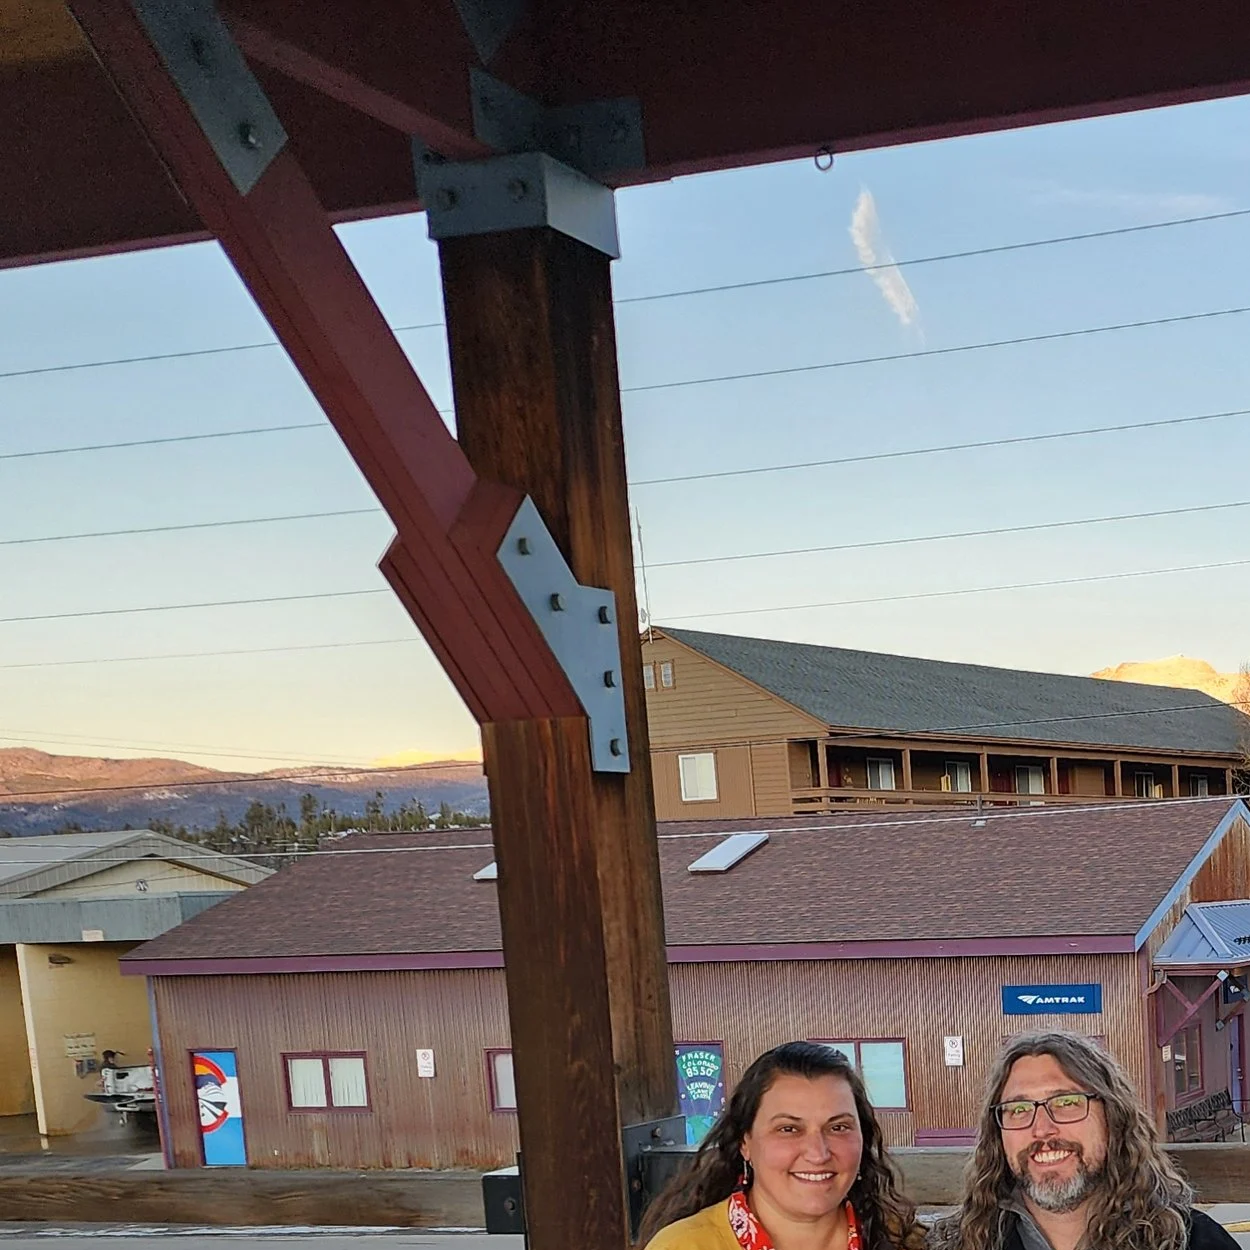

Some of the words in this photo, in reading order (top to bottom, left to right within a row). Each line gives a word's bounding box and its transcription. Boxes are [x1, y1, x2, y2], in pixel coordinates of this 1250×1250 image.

[1036, 996, 1085, 1004] AMTRAK
[682, 1052, 716, 1062] FRASER
[682, 1060, 719, 1070] COLORADO
[686, 1066, 714, 1077] 8550
